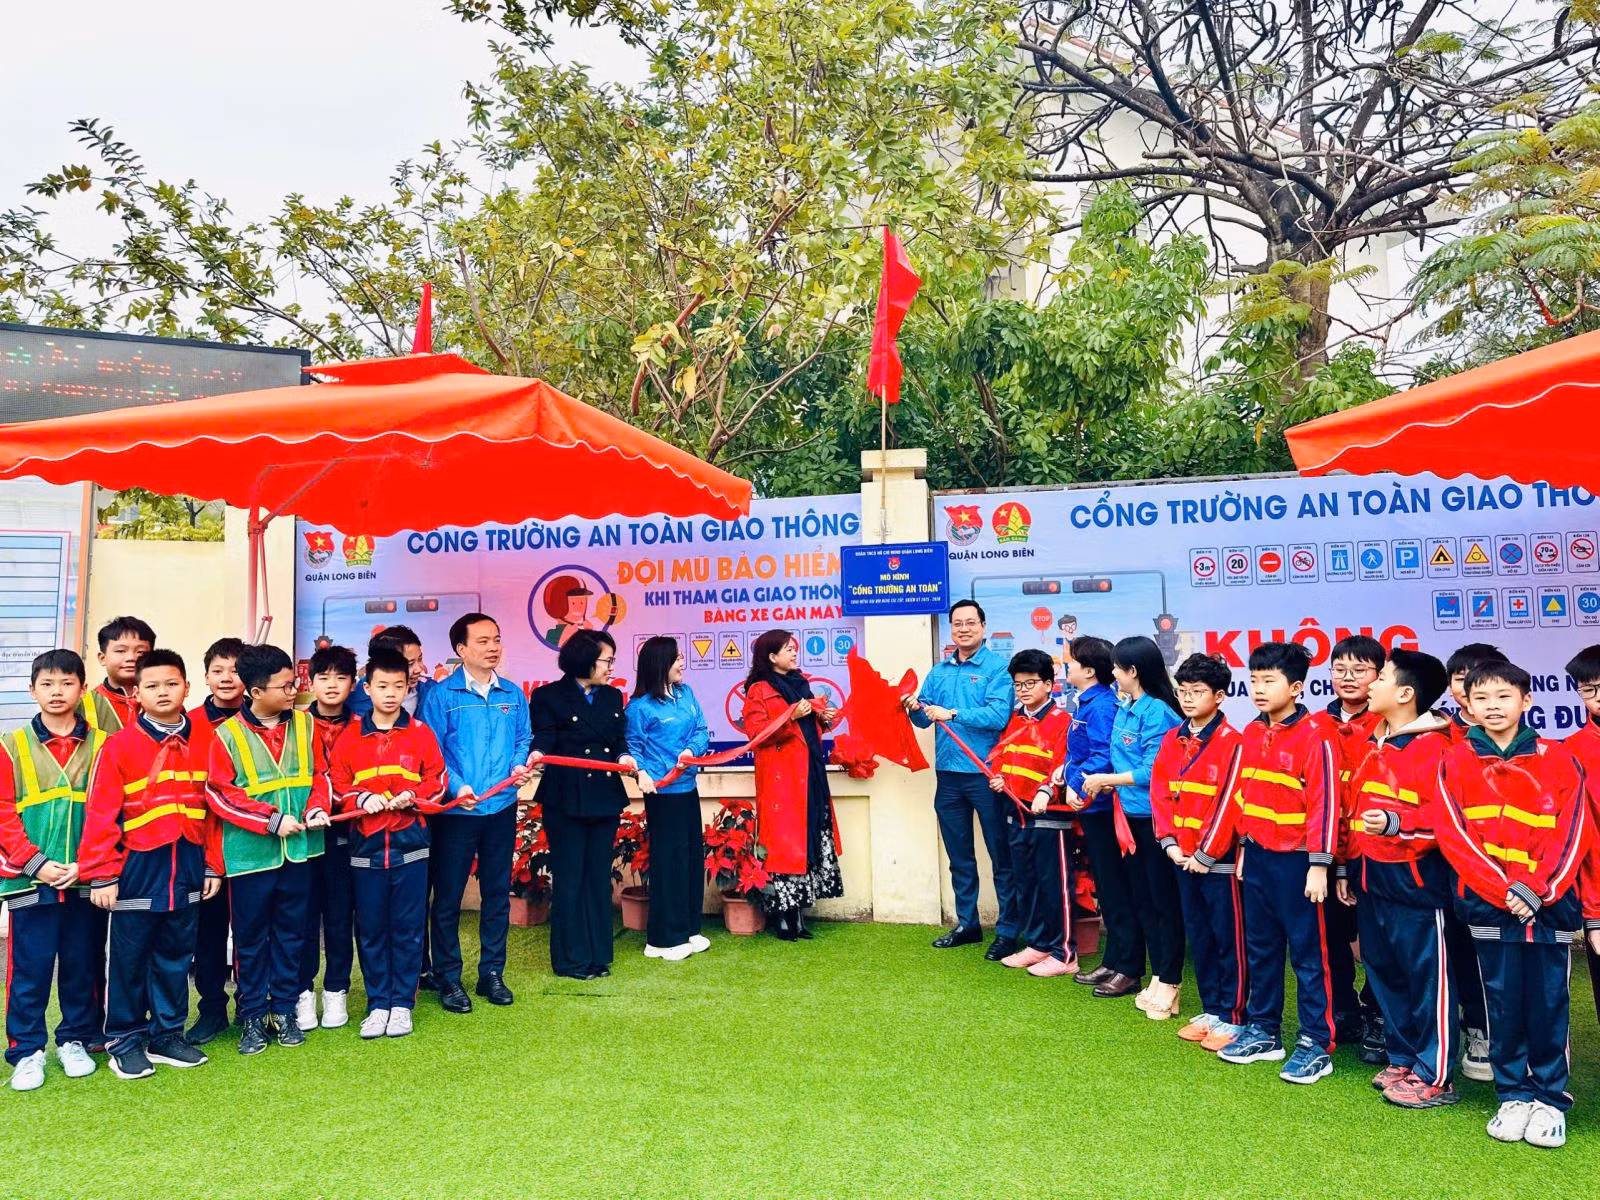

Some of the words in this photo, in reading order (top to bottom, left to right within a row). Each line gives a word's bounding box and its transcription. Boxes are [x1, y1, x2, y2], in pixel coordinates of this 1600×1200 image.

[1070, 490, 1158, 529] CỔNG
[1167, 490, 1287, 524] TRƯỜNG
[1297, 492, 1339, 519] AN
[1348, 481, 1431, 516] TOÀN
[1442, 483, 1523, 512] GIAO
[485, 522, 581, 551] TRƯỜNG
[588, 524, 621, 547] AN
[628, 516, 693, 545] TOÀN
[701, 518, 764, 544] GIAO
[772, 508, 859, 538] THÔNG
[949, 550, 978, 562] QUẬN
[981, 550, 1009, 559] LONG
[1012, 548, 1034, 557] BIÊN
[1401, 550, 1414, 566] P
[717, 550, 777, 581] BẢO
[1231, 559, 1244, 569] 20
[305, 572, 330, 583] QUẬN
[332, 572, 355, 580] LONG
[358, 570, 376, 580] BIÊN
[644, 591, 670, 606] KHI
[673, 589, 717, 606] THAM
[721, 588, 750, 604] GIA
[754, 586, 796, 603] GIAO
[800, 583, 842, 600] THÔN
[906, 584, 916, 593] AN
[1582, 598, 1597, 608] 30
[704, 607, 746, 623] BẰNG
[750, 608, 769, 621] XE
[772, 605, 806, 620] GẮN
[838, 640, 850, 650] 30
